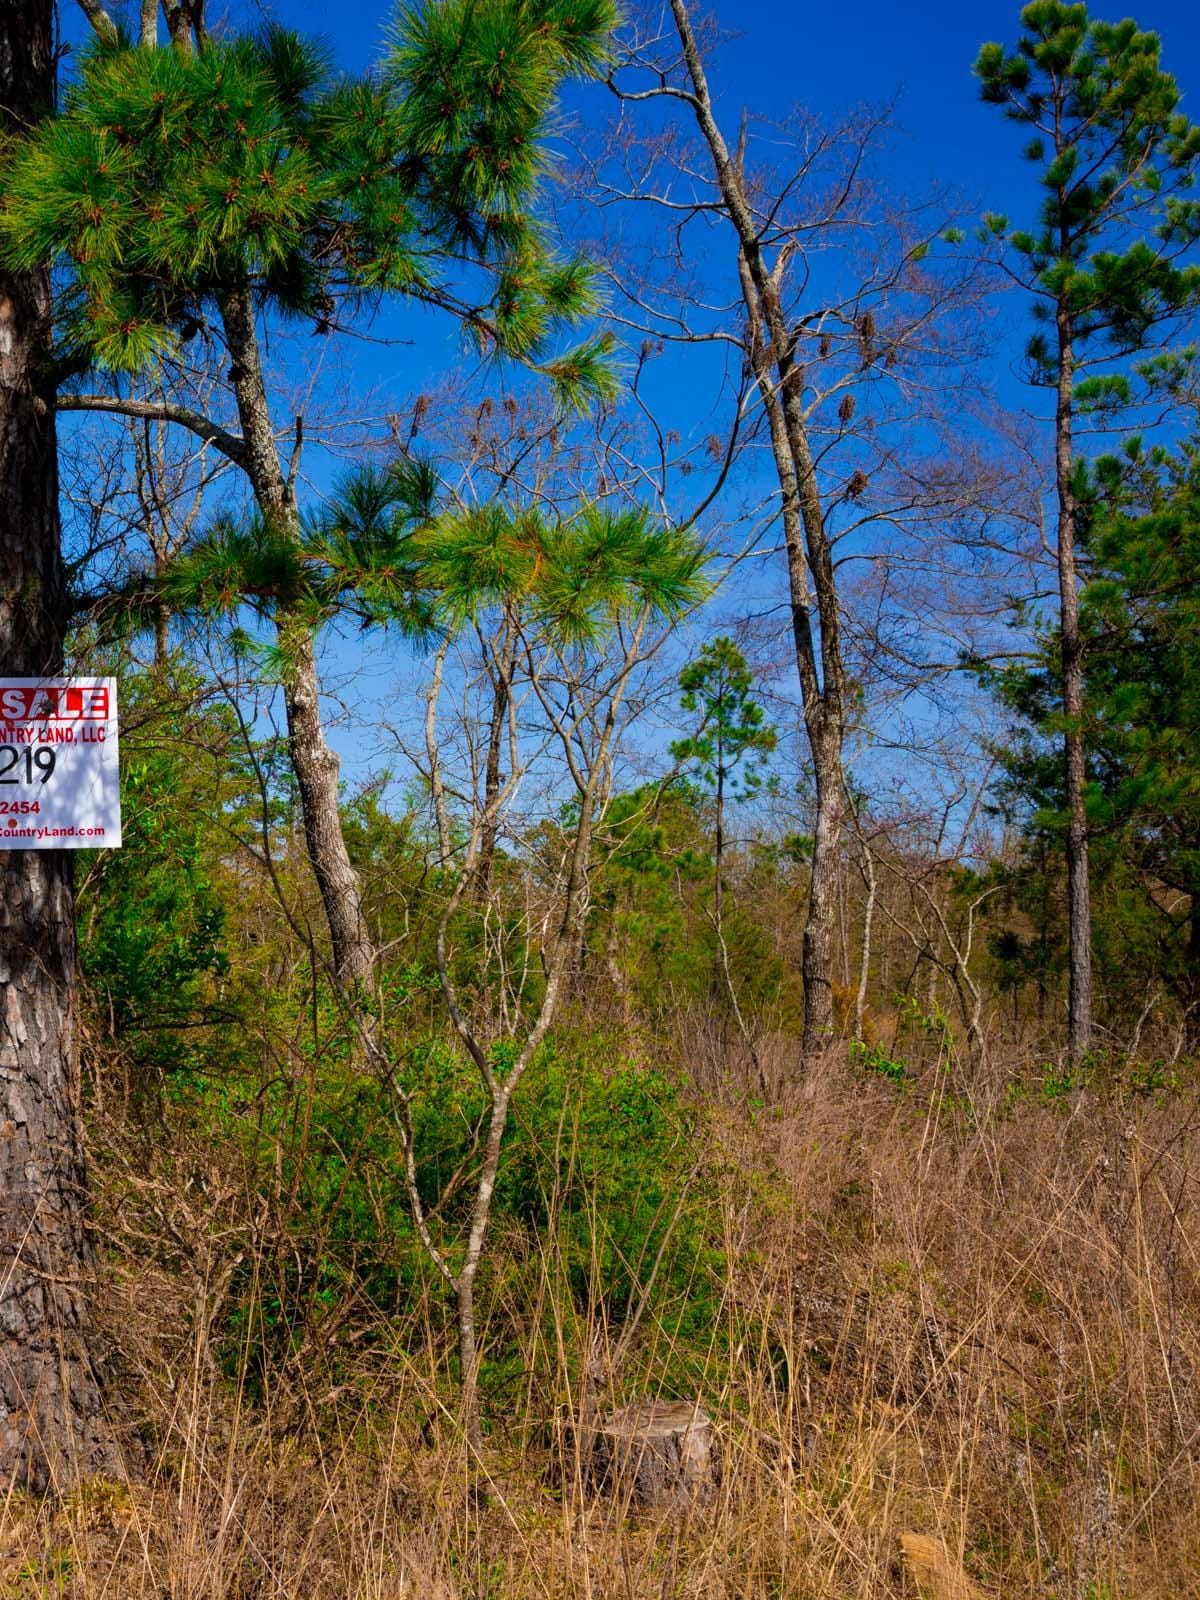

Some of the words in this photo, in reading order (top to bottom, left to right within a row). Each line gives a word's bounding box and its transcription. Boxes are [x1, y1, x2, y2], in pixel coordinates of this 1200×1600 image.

[2, 690, 105, 720] SALE
[38, 728, 77, 745] LAND,
[82, 728, 106, 743] LLC
